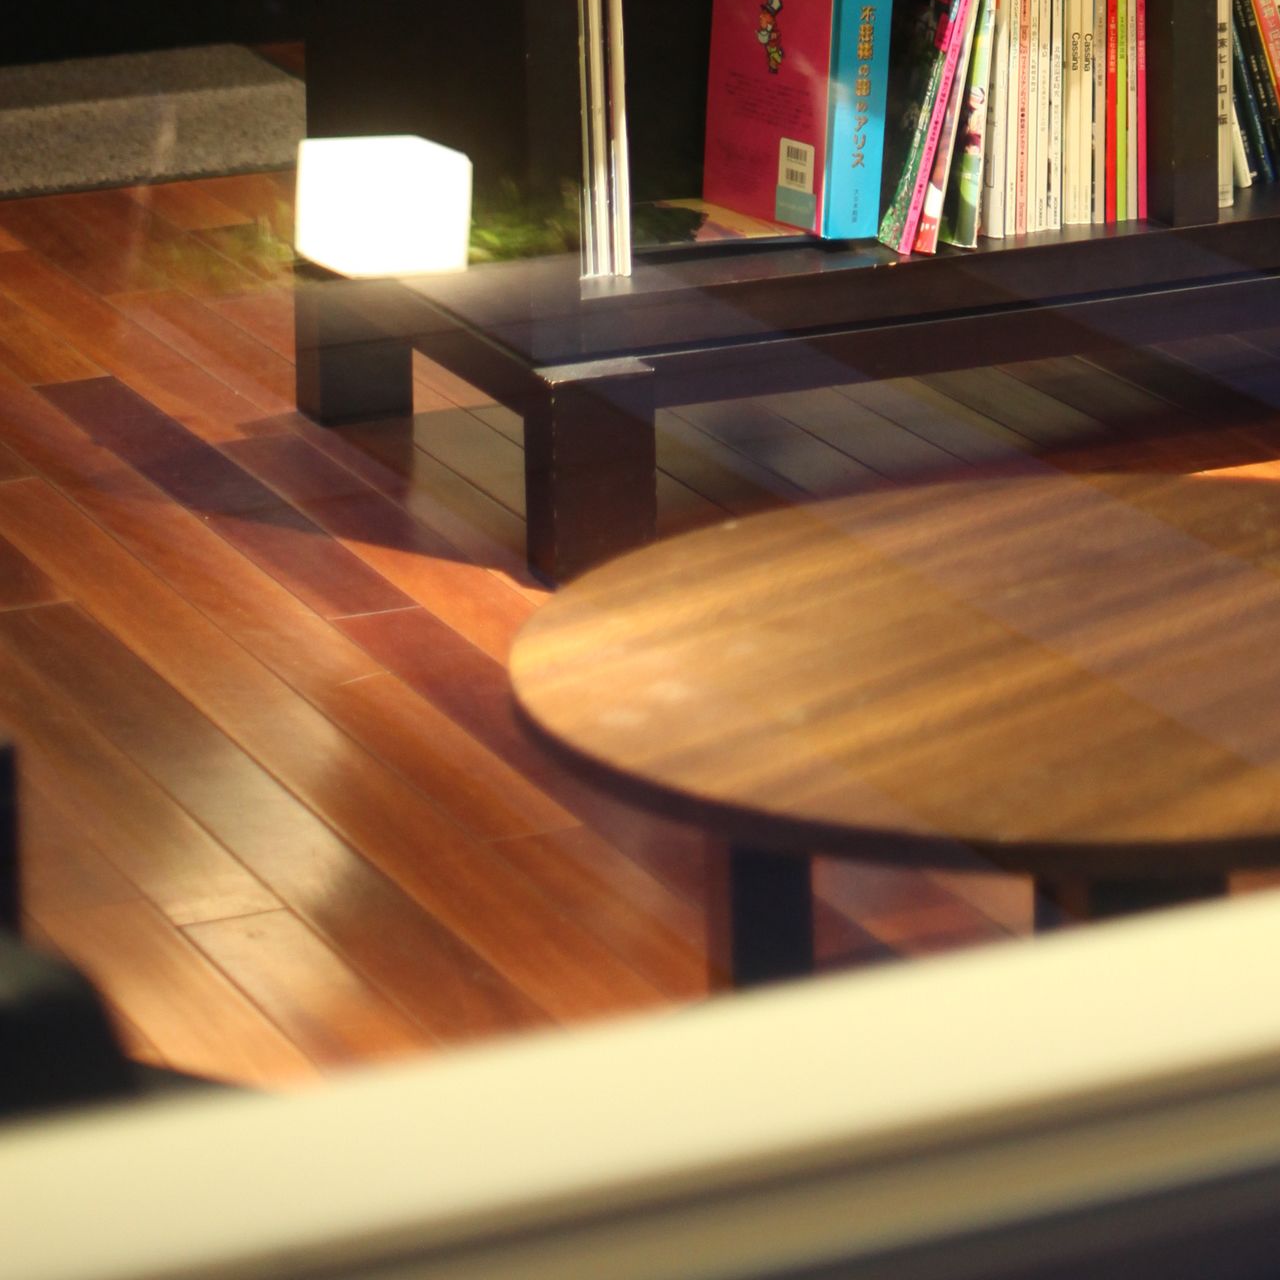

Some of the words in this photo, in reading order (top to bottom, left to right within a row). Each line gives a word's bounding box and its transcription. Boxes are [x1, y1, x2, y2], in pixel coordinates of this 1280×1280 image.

[1071, 31, 1082, 72] Cassina
[1083, 32, 1094, 73] Cassina
[851, 6, 876, 170] 不思議の国のアリス
